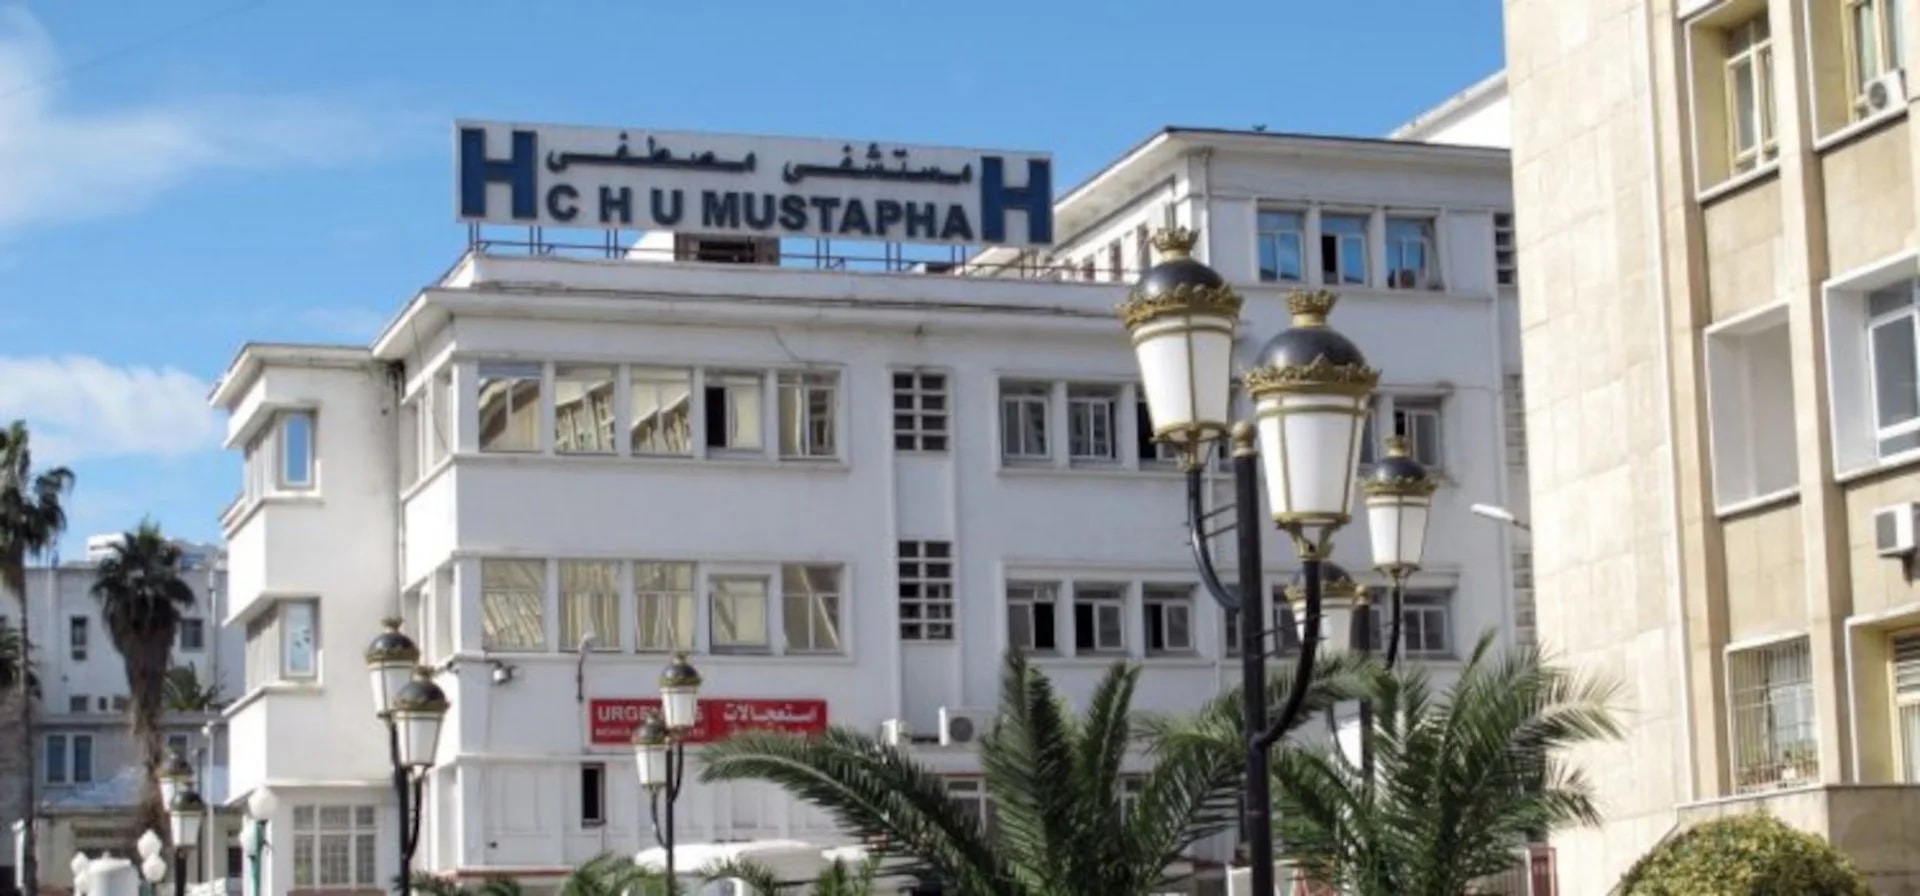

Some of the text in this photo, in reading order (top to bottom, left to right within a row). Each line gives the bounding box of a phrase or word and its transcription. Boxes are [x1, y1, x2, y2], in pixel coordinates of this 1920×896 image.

[461, 128, 538, 219] H
[702, 191, 974, 239] MUSTAPHA
[981, 156, 1052, 243] H
